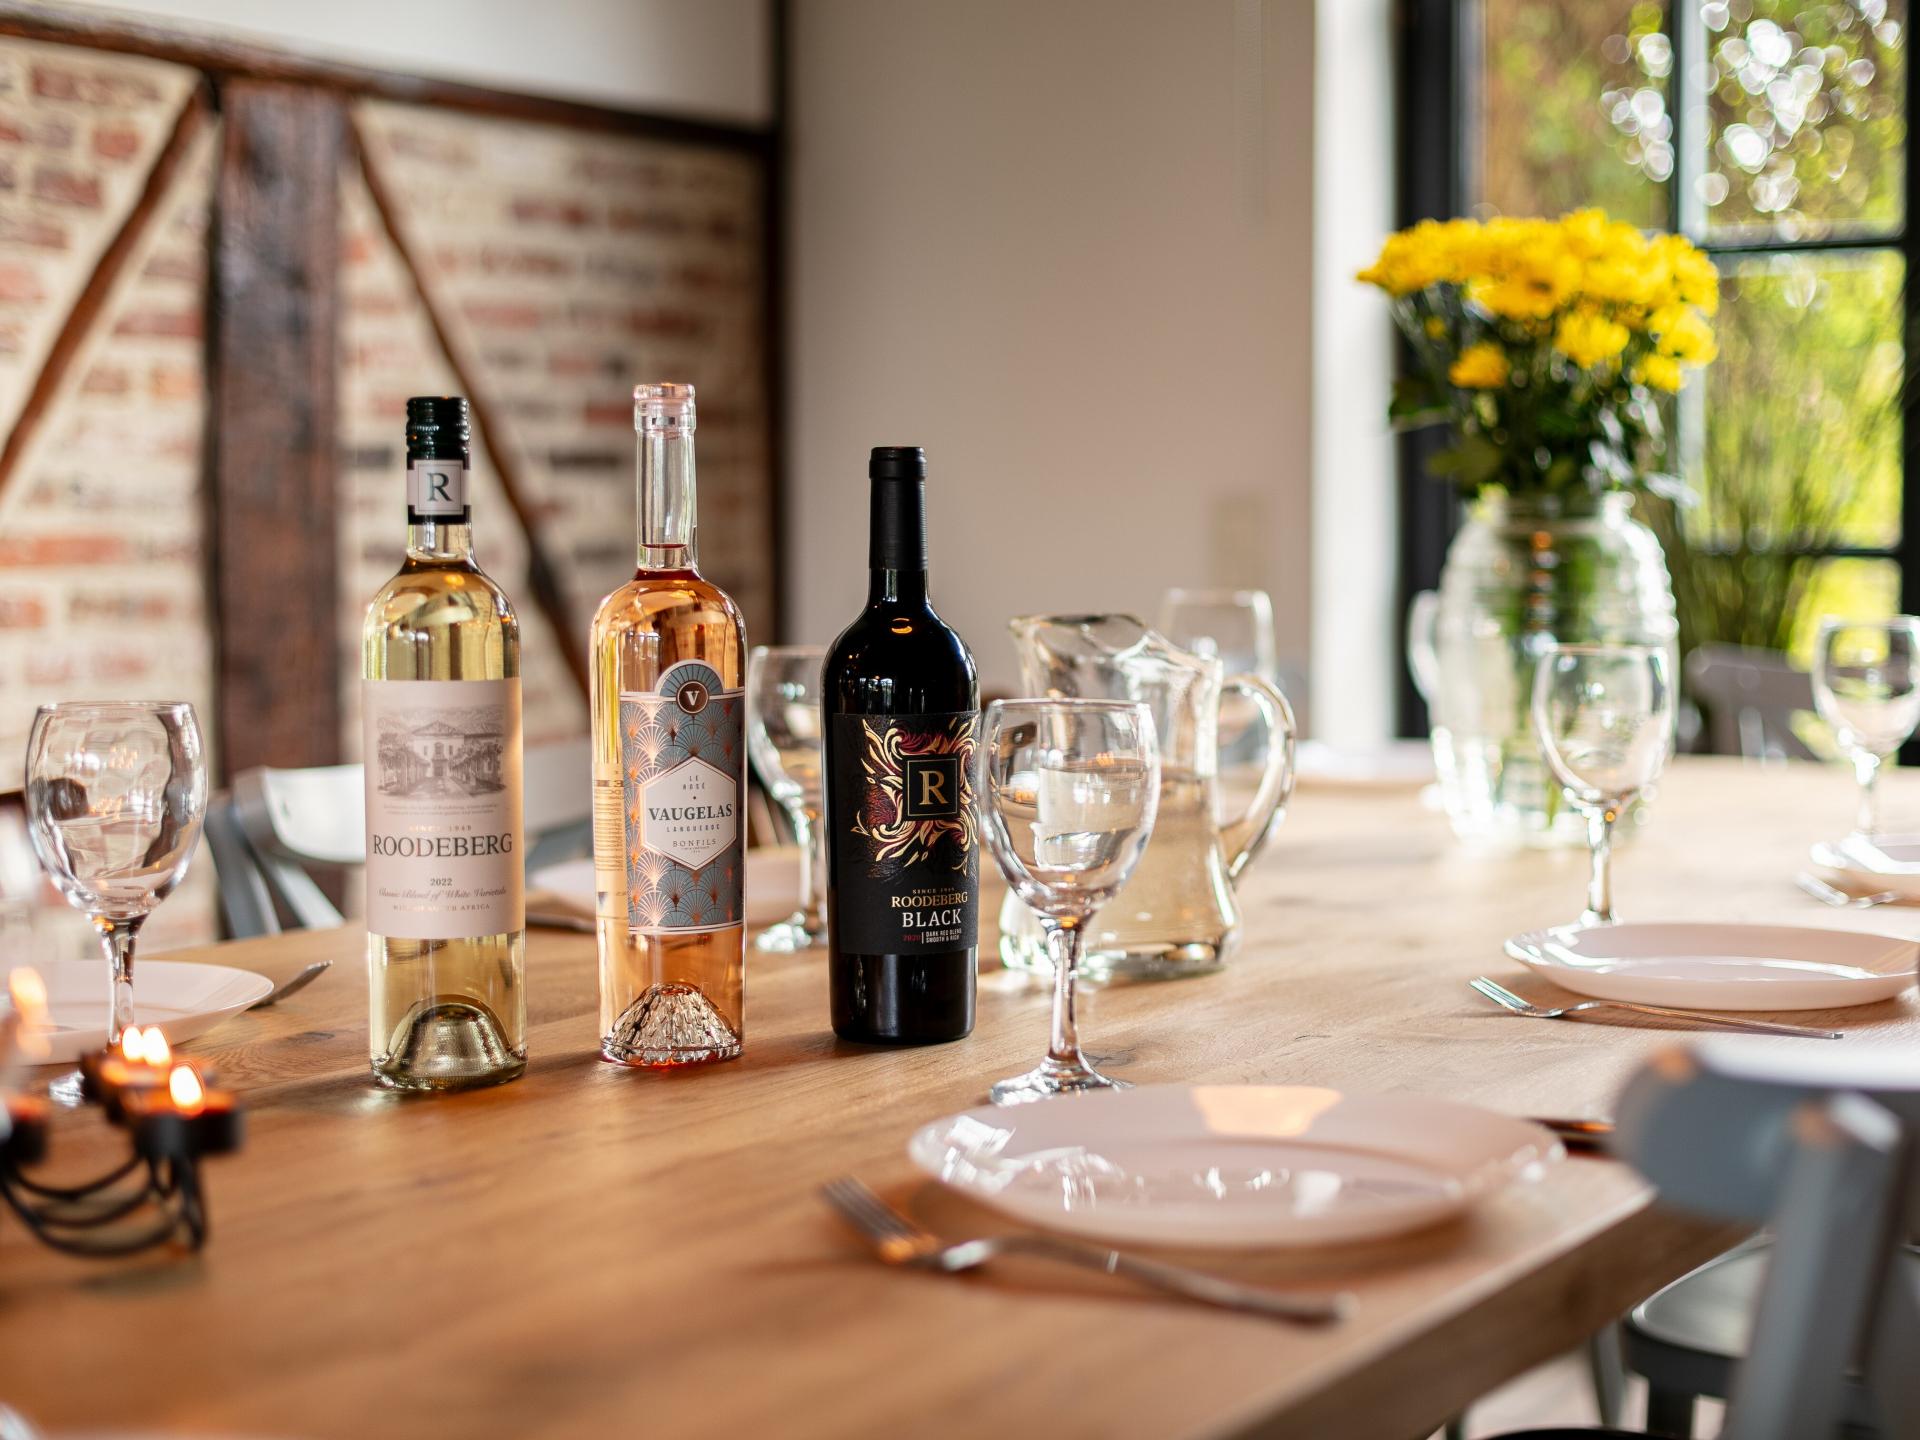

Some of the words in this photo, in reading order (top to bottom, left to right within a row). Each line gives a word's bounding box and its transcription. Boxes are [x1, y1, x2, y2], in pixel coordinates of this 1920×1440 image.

[427, 472, 452, 502] R
[686, 690, 699, 706] V
[918, 770, 949, 805] R
[649, 803, 732, 821] VAUGELAS
[373, 833, 512, 857] ROODEBERG
[673, 839, 716, 847] BONFILS
[430, 877, 453, 886] 2022
[891, 892, 968, 908] ROODEBERG
[902, 909, 961, 927] BLACK
